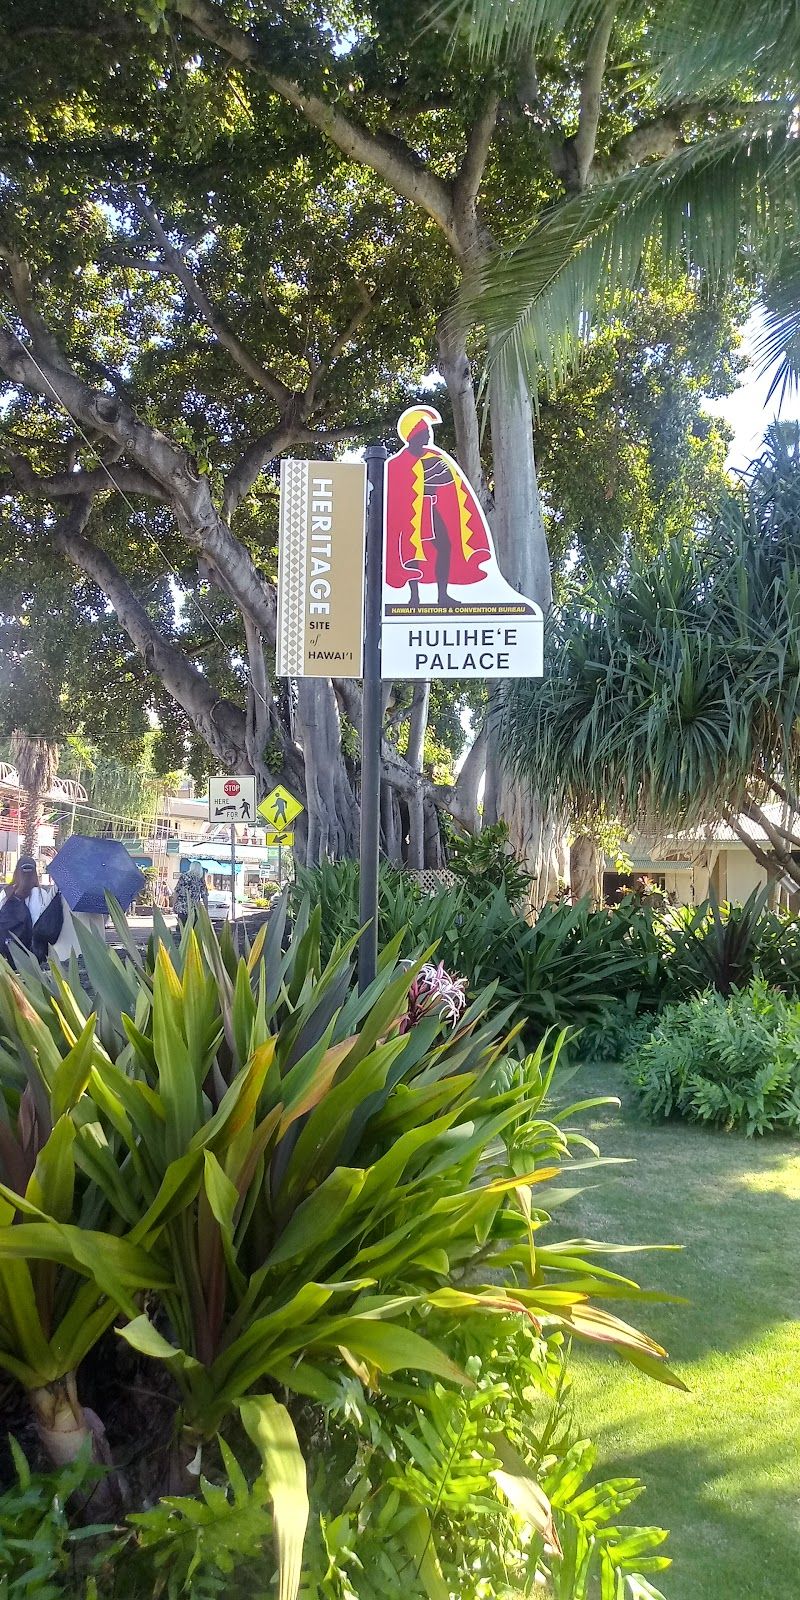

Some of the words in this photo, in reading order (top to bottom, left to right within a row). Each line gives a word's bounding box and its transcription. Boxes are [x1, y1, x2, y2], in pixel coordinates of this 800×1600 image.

[309, 478, 333, 615] HERITAGE
[309, 621, 330, 630] SITE
[309, 633, 320, 647] of
[415, 652, 510, 670] PALACE
